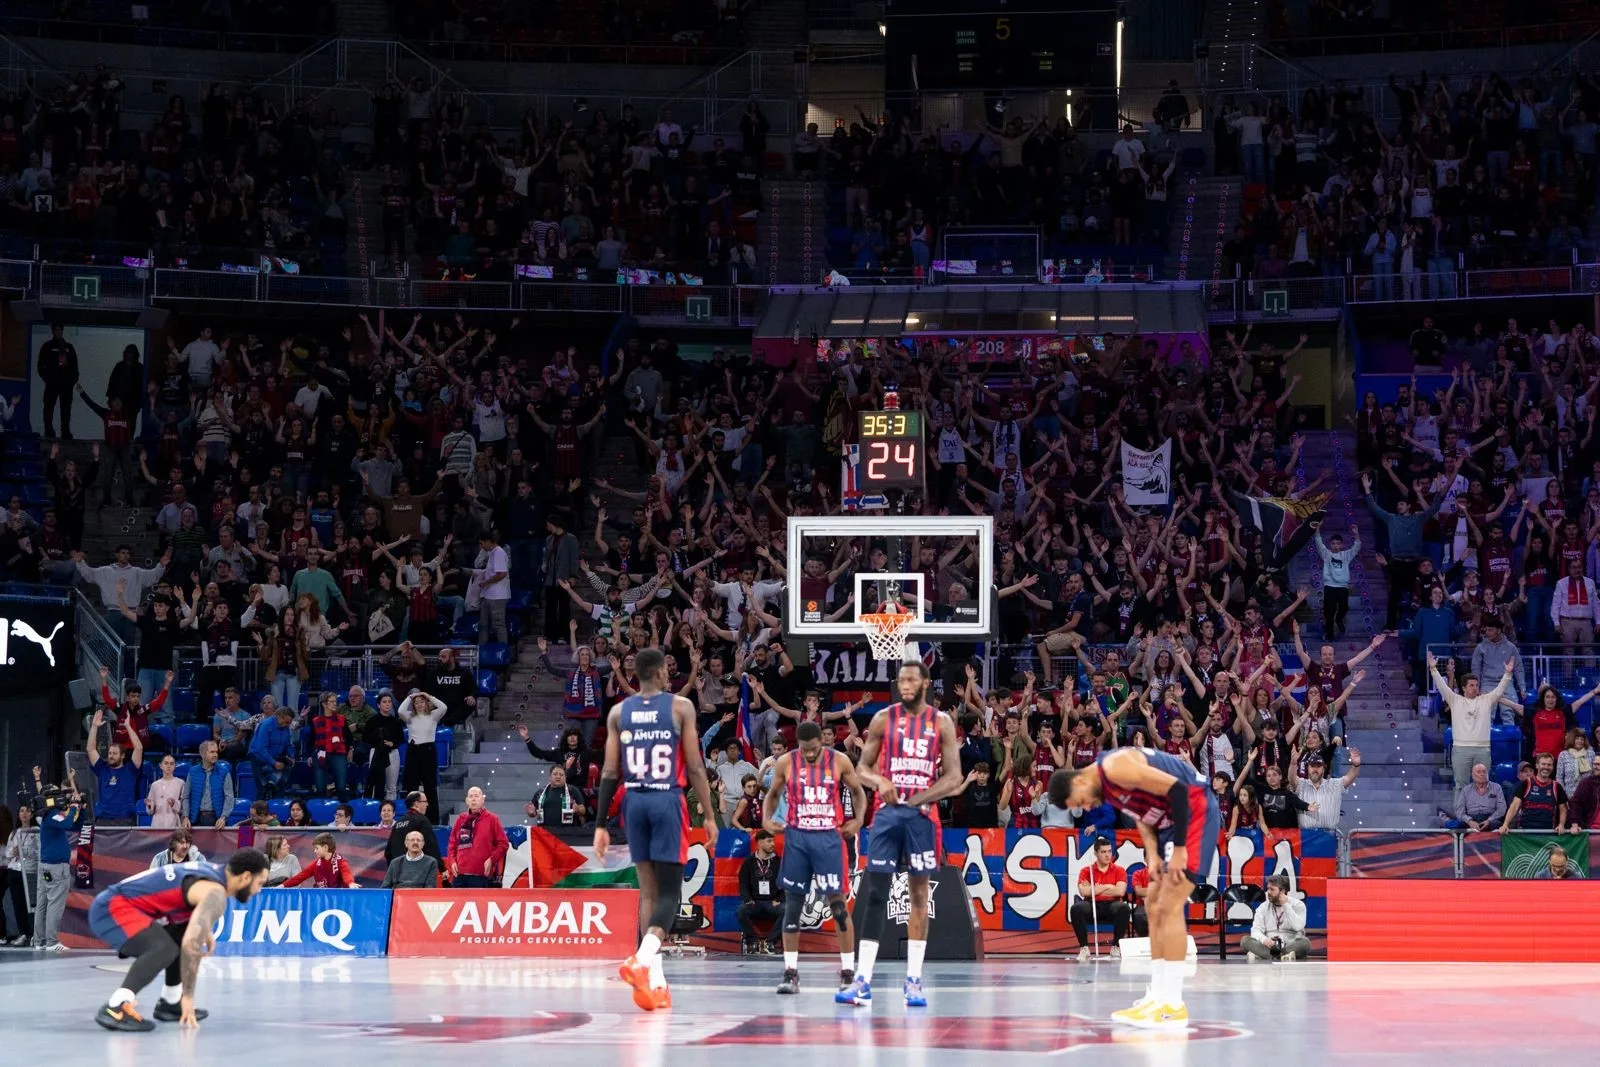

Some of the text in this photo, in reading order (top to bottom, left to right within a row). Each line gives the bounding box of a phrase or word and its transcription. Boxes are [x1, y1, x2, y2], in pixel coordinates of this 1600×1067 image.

[995, 17, 1011, 40] 5
[976, 341, 1004, 354] 208
[863, 415, 905, 435] 35:3
[868, 442, 914, 479] 24
[436, 675, 462, 685] VANS
[634, 730, 672, 741] AMUTIO
[902, 737, 929, 758] 45
[626, 744, 673, 779] 46
[804, 786, 829, 803] 44
[396, 820, 410, 829] STAFF
[910, 850, 937, 871] 45
[816, 873, 840, 891] 44
[451, 901, 612, 935] AMBAR
[460, 936, 603, 944] PEQUEÑOS CERVECEROS
